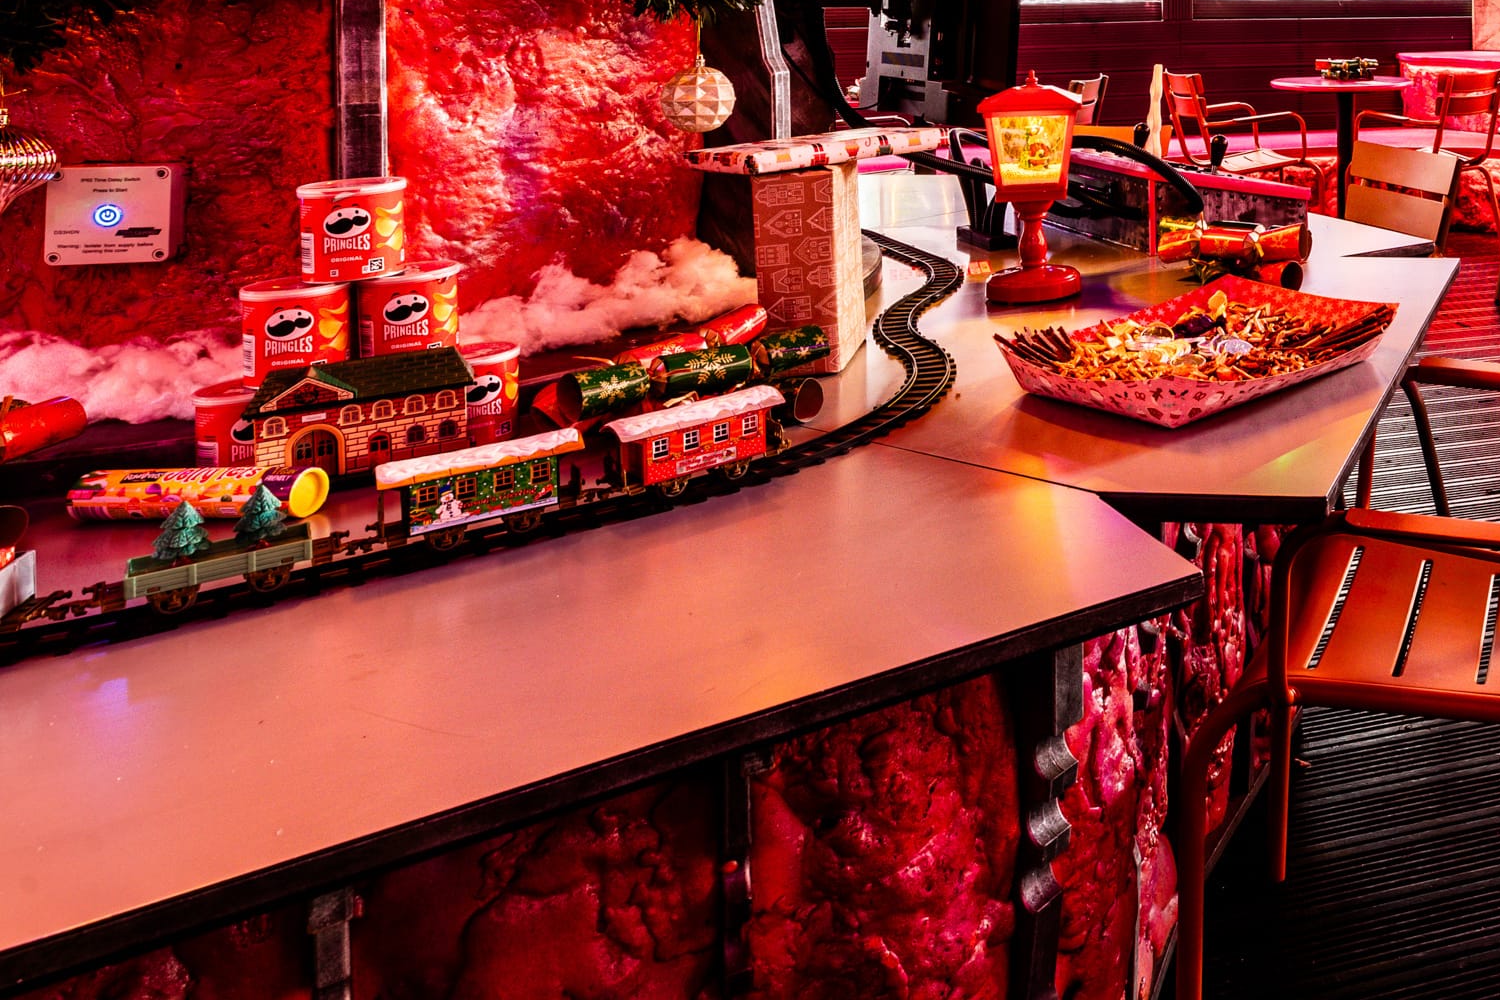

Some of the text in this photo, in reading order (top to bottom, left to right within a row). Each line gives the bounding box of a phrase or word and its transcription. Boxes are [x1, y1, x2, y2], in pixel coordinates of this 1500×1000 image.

[323, 233, 371, 254] PRINGLES
[330, 255, 363, 263] ORIGINAL
[383, 319, 429, 340] PRINGLES
[264, 336, 313, 357] PRINGLES
[391, 341, 422, 350] ORIGINAL
[271, 358, 305, 366] ORIGINAL
[467, 398, 502, 419] RINGLES
